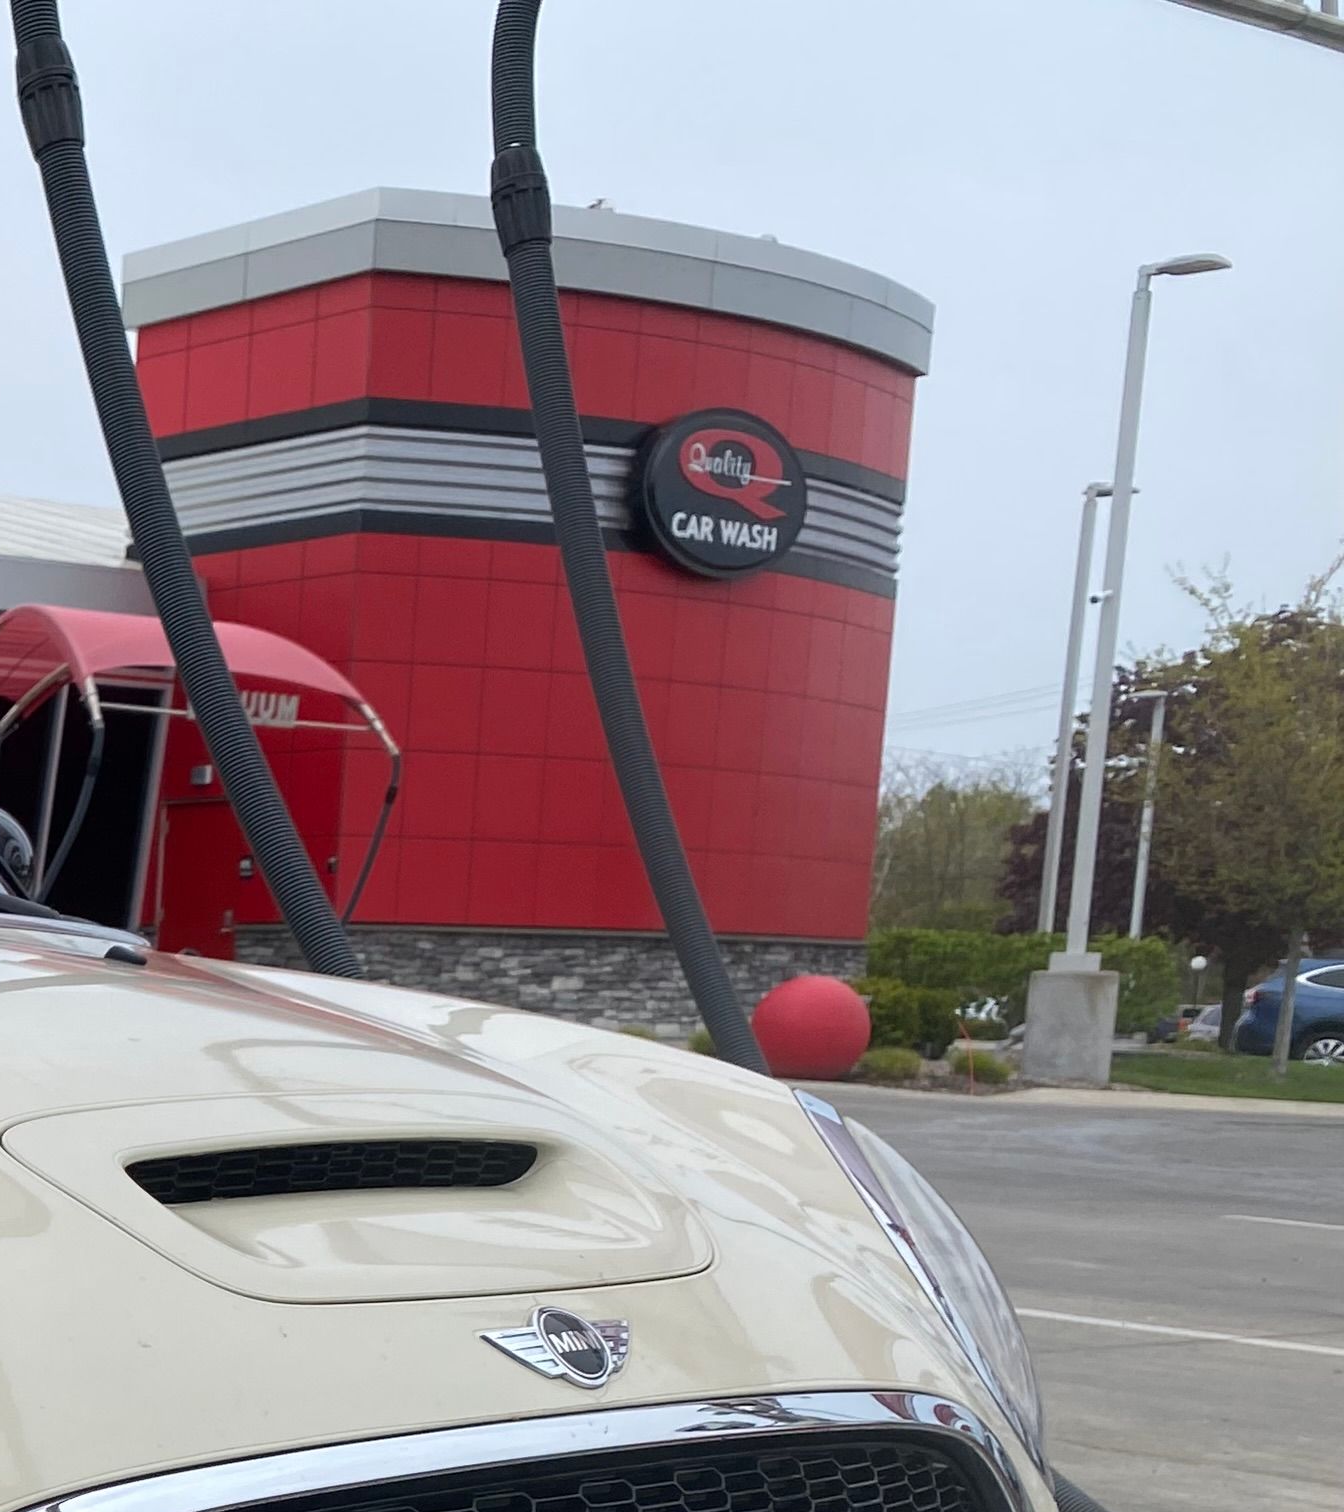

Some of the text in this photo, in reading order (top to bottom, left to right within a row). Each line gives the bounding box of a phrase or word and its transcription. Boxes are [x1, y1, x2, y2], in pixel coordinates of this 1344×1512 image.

[687, 442, 792, 486] Quality
[671, 511, 778, 552] CAR WASH
[548, 1330, 602, 1354] MINI
